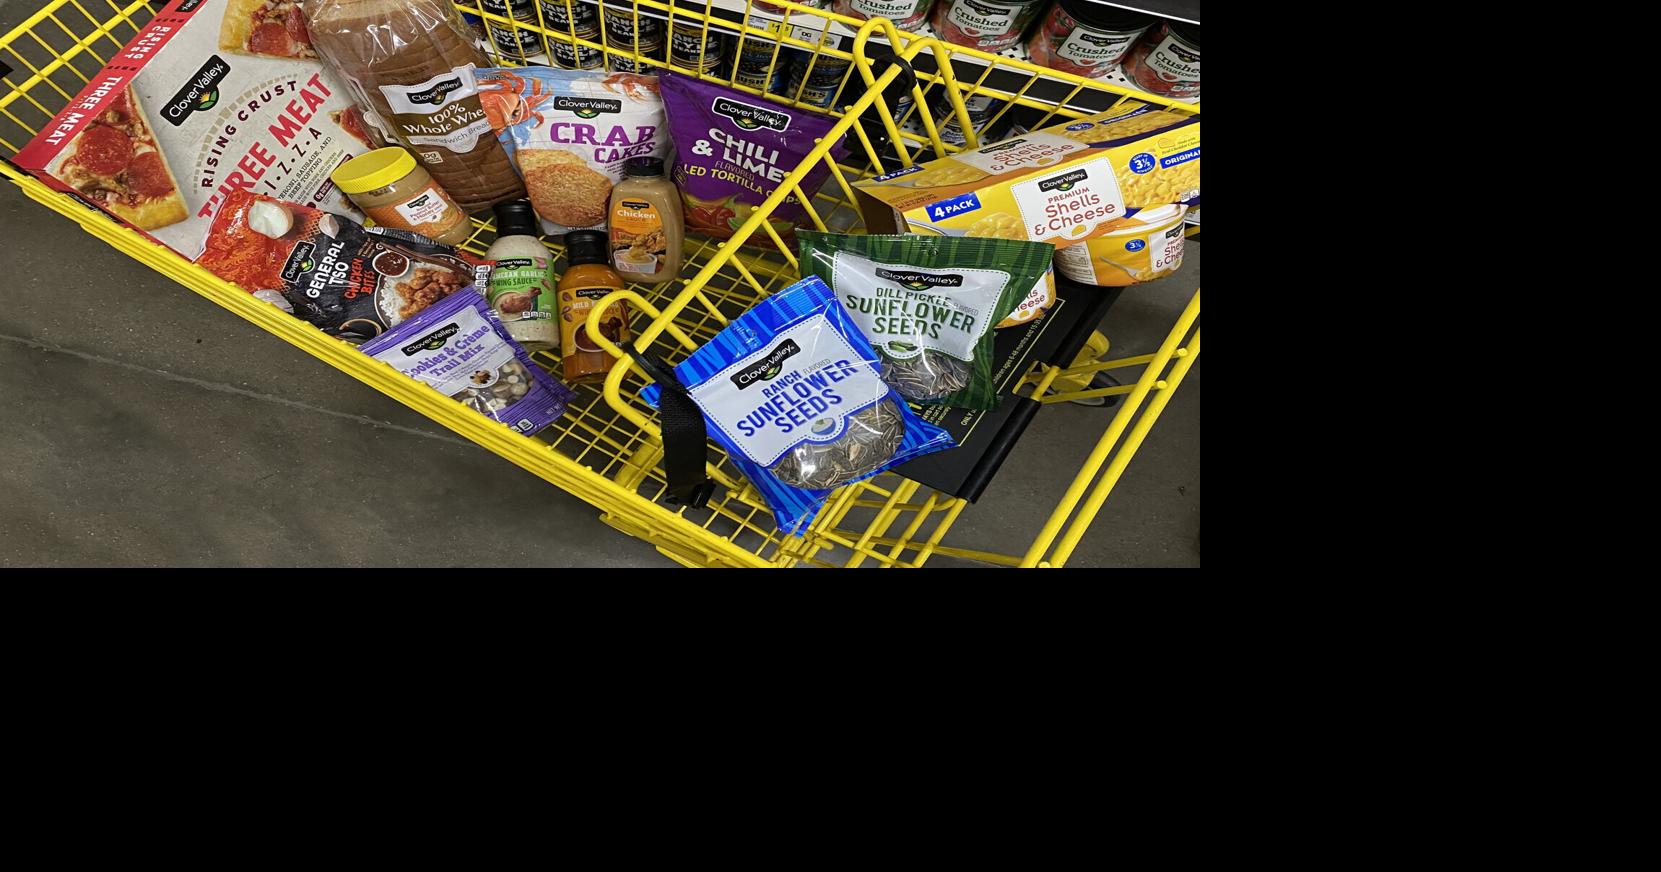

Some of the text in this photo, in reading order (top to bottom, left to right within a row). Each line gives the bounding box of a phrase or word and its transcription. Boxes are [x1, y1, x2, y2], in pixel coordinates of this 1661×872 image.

[858, 0, 912, 10] rushed
[860, 4, 905, 15] Tomatoes
[955, 6, 1008, 26] Crushed
[955, 15, 1000, 31] Tomatoes
[124, 25, 162, 59] CRUST
[135, 26, 171, 60] RISING
[1067, 42, 1125, 54] Crushed
[1068, 50, 1116, 59] Tomatoes
[1155, 60, 1199, 78] Tomatoes
[80, 76, 123, 110] THREE
[169, 90, 198, 118] Clover
[411, 90, 438, 102] Clover
[267, 72, 332, 148] MEAT
[428, 103, 466, 124] 100%
[558, 100, 616, 111] Clover Valley
[719, 102, 779, 126] Clover Valley
[45, 112, 85, 146] MEAT
[402, 108, 486, 134] Whole Whe
[201, 80, 297, 188] RISING CRUST
[319, 136, 332, 151] AND
[550, 122, 656, 146] CRAB
[709, 128, 779, 164] CHILI
[594, 142, 655, 163] CAKES
[691, 139, 785, 183] & LIME
[993, 143, 1052, 162] Shells
[1001, 143, 1074, 168] Cheese
[1164, 150, 1200, 165] ORIGINA
[300, 157, 323, 183] TOPPING
[684, 163, 706, 176] LED
[711, 168, 763, 195] TORTILLA
[714, 160, 755, 181] FLAVORED
[891, 167, 917, 178] PACK
[1042, 173, 1084, 189] Clover Valley
[1044, 193, 1100, 218] Shells
[1048, 187, 1090, 203] PREMIUM
[617, 210, 656, 219] Chicken
[934, 206, 945, 219] 4
[946, 199, 974, 214] PACK
[1034, 203, 1116, 236] & Cheese
[286, 259, 299, 278] Clover
[306, 241, 345, 299] GENERAL
[329, 261, 349, 286] TSO
[1156, 260, 1163, 268] &
[344, 258, 364, 299] CHICKEN
[360, 270, 375, 295] BITES
[496, 277, 533, 286] WING SAUCE
[881, 270, 955, 286] Clover Valley
[876, 287, 903, 300] DILL
[906, 290, 952, 306] PICKLE
[1016, 294, 1045, 311] eese
[846, 294, 976, 334] SUNFLOWER
[407, 328, 456, 352] Clover Valley
[447, 346, 458, 356] &
[455, 325, 491, 350] Crème
[872, 317, 942, 340] SEEDS
[429, 354, 461, 377] Trail
[458, 342, 485, 362] Mix
[739, 346, 792, 385] Clover Valley
[761, 358, 832, 397] RANCH FLAVORED
[737, 359, 858, 437] SUNFLOWER
[774, 388, 843, 433] SEEDS
